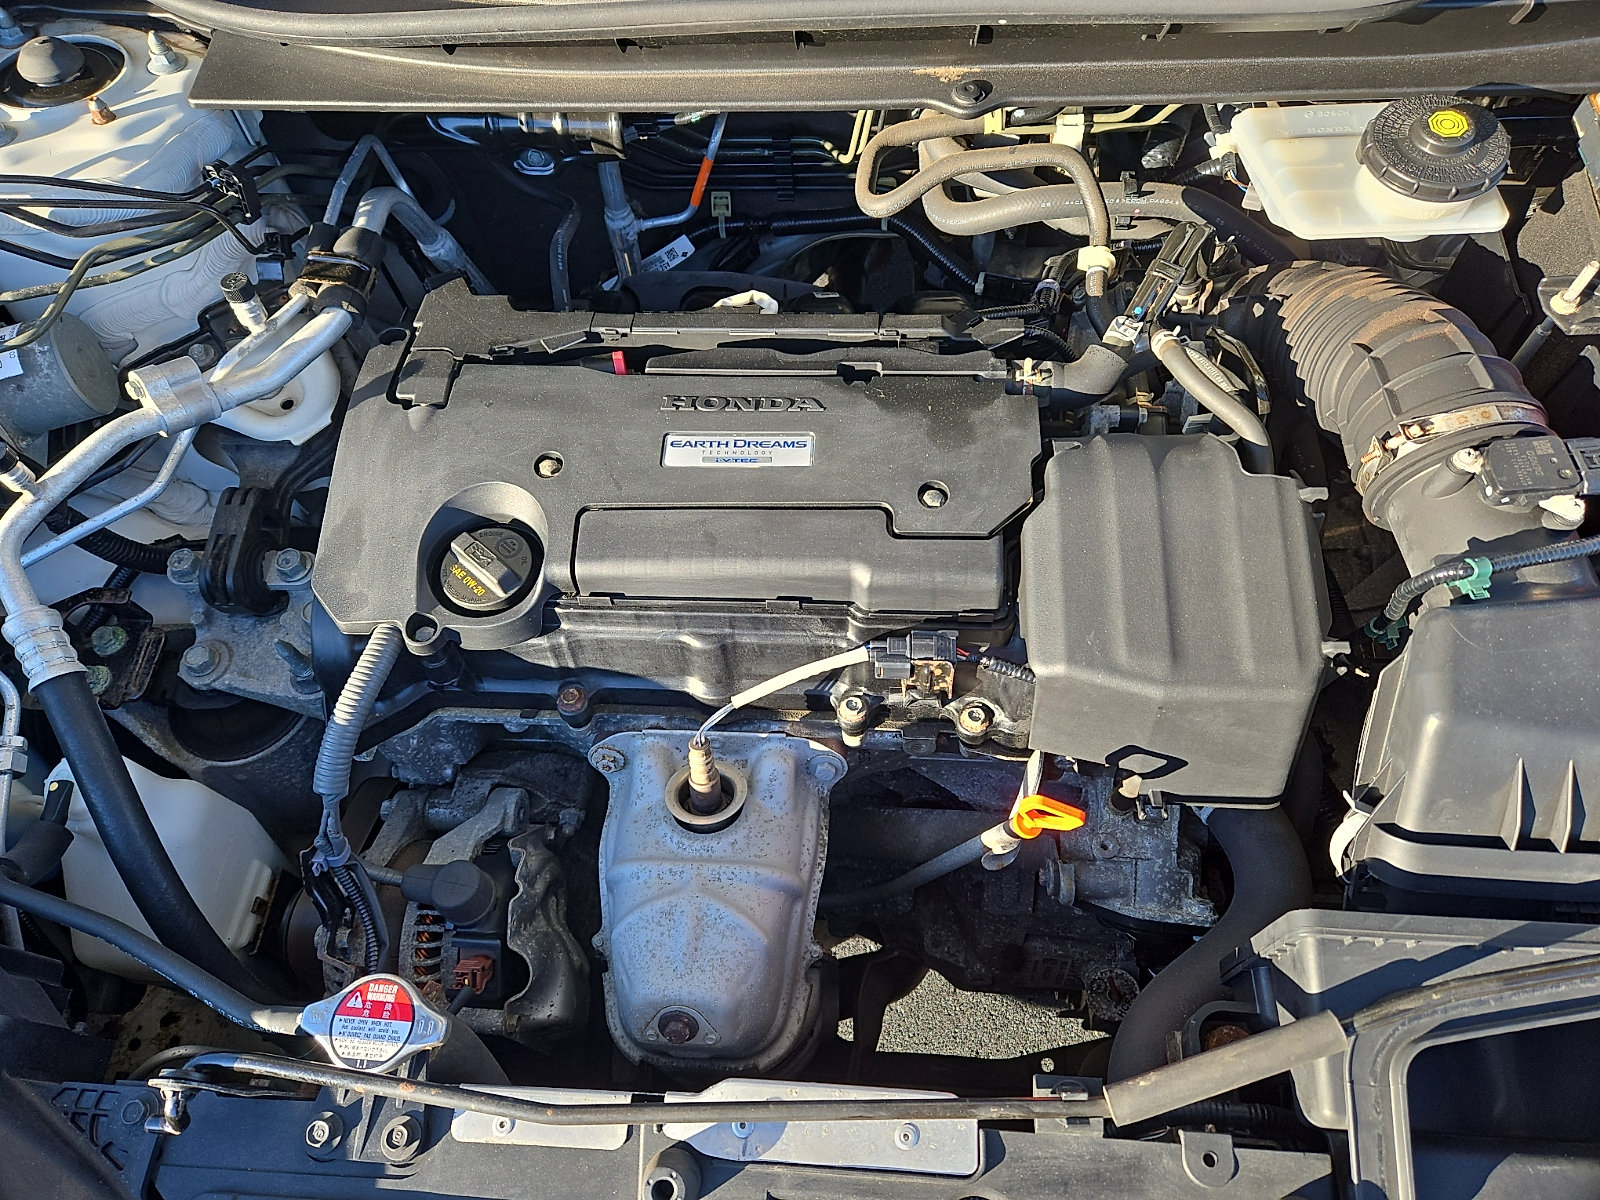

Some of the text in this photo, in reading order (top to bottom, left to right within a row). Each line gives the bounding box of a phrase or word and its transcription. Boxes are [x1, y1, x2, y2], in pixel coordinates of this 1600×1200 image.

[660, 395, 827, 412] HONDA
[670, 439, 808, 449] EARTH DREAMS
[450, 564, 486, 597] SAE 0W-20
[369, 983, 398, 995] DANGER
[366, 992, 396, 1003] WARNING
[356, 1059, 367, 1069] 1.1
